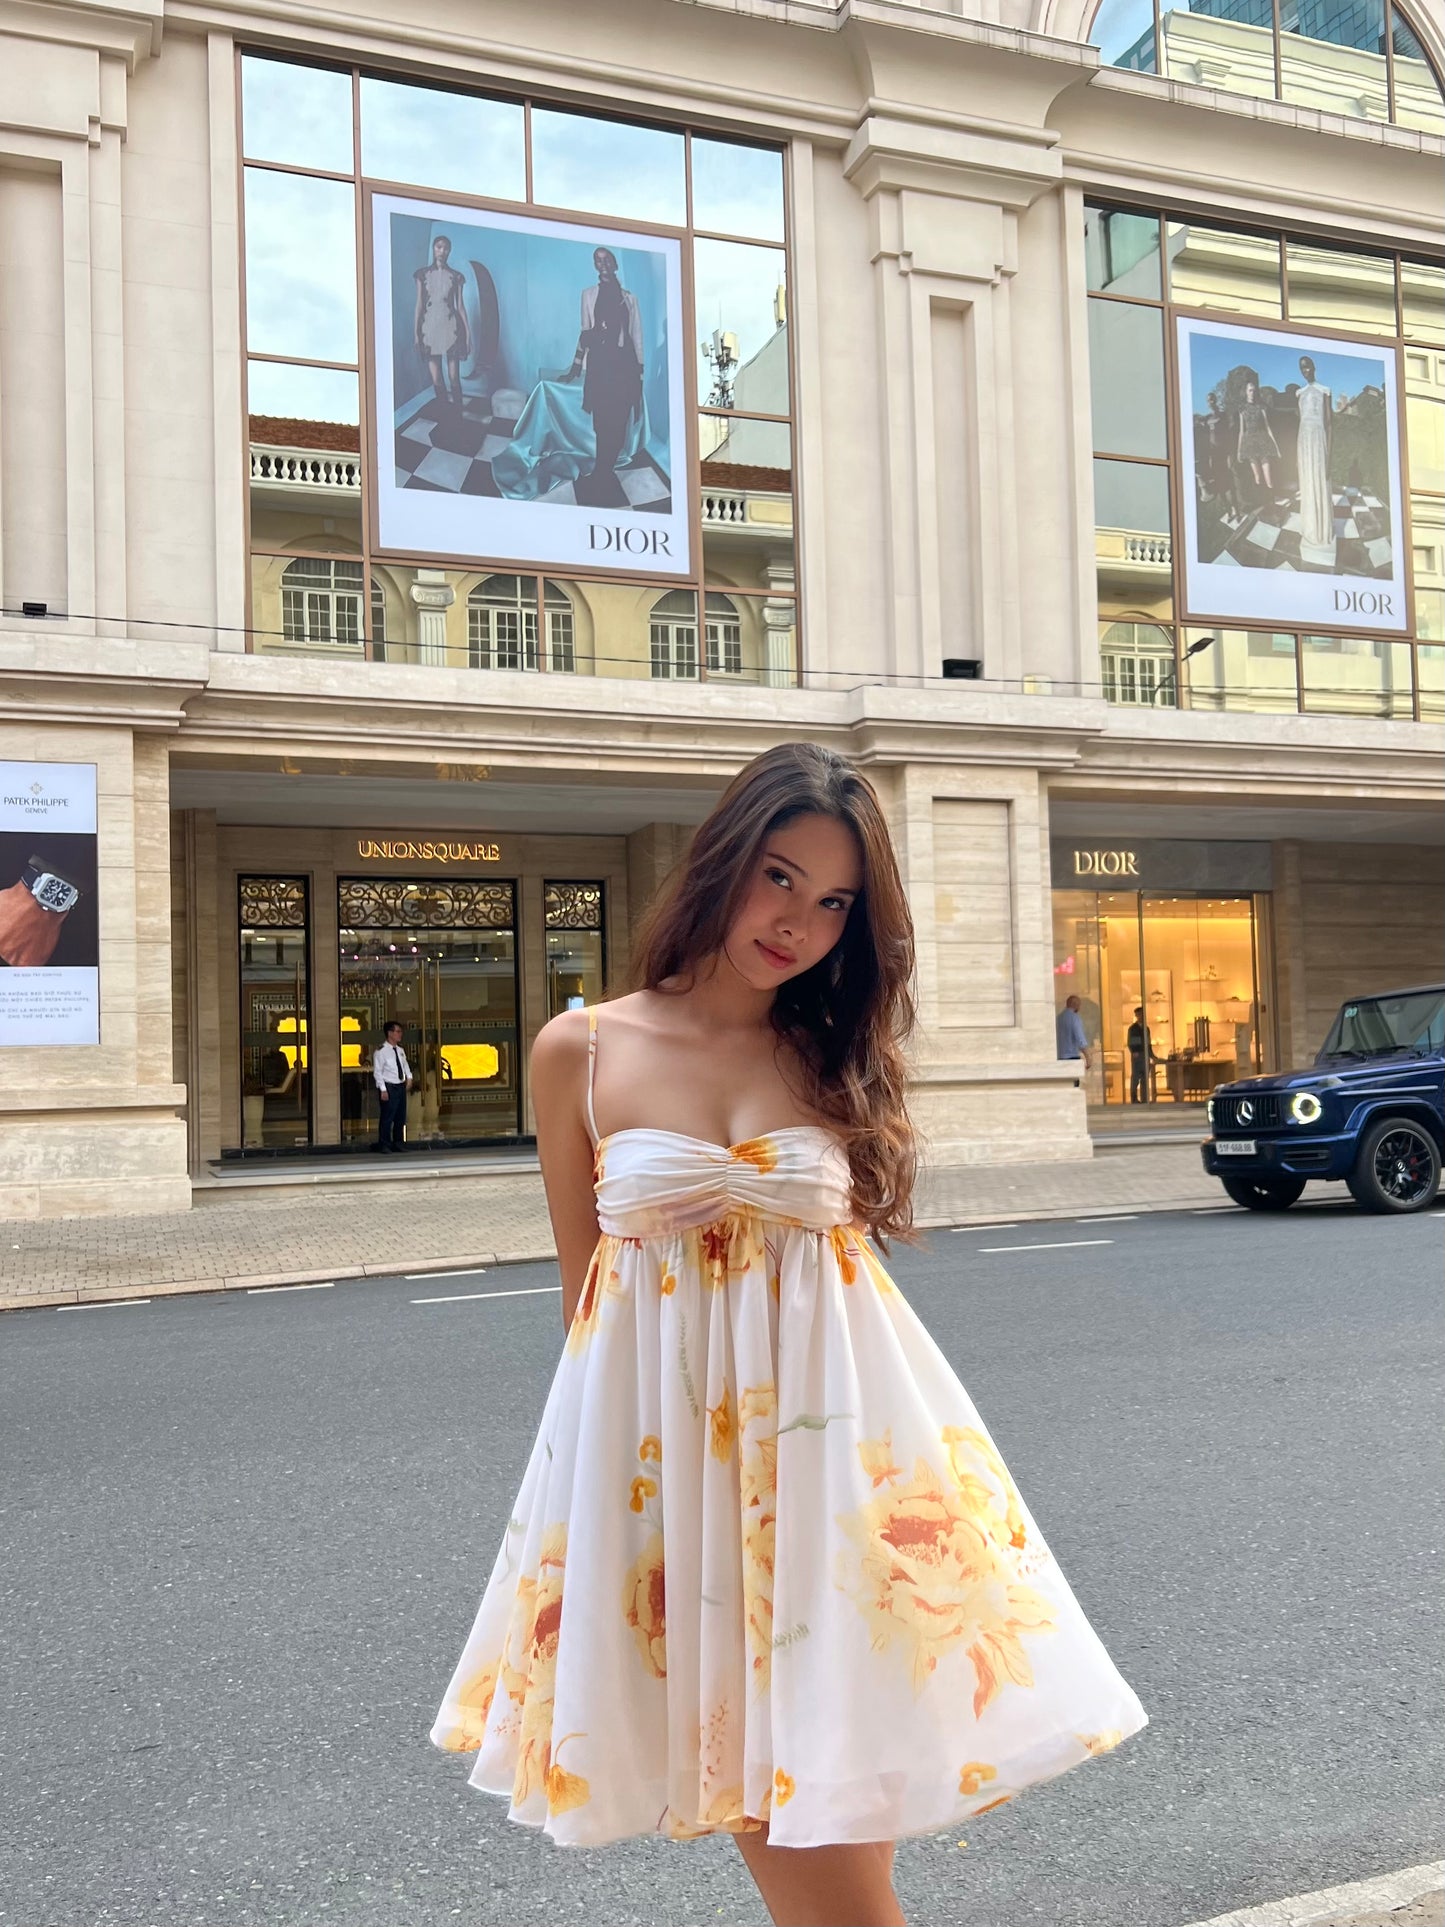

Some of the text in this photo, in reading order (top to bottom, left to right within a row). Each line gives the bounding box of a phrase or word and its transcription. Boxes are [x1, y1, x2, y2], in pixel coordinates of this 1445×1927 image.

[587, 524, 674, 557] DIOR
[1333, 589, 1395, 616] DIOR
[3, 796, 69, 807] PATEK PHILIPPE
[357, 840, 500, 863] UNIONSQUARE
[1074, 850, 1140, 875] DIOR
